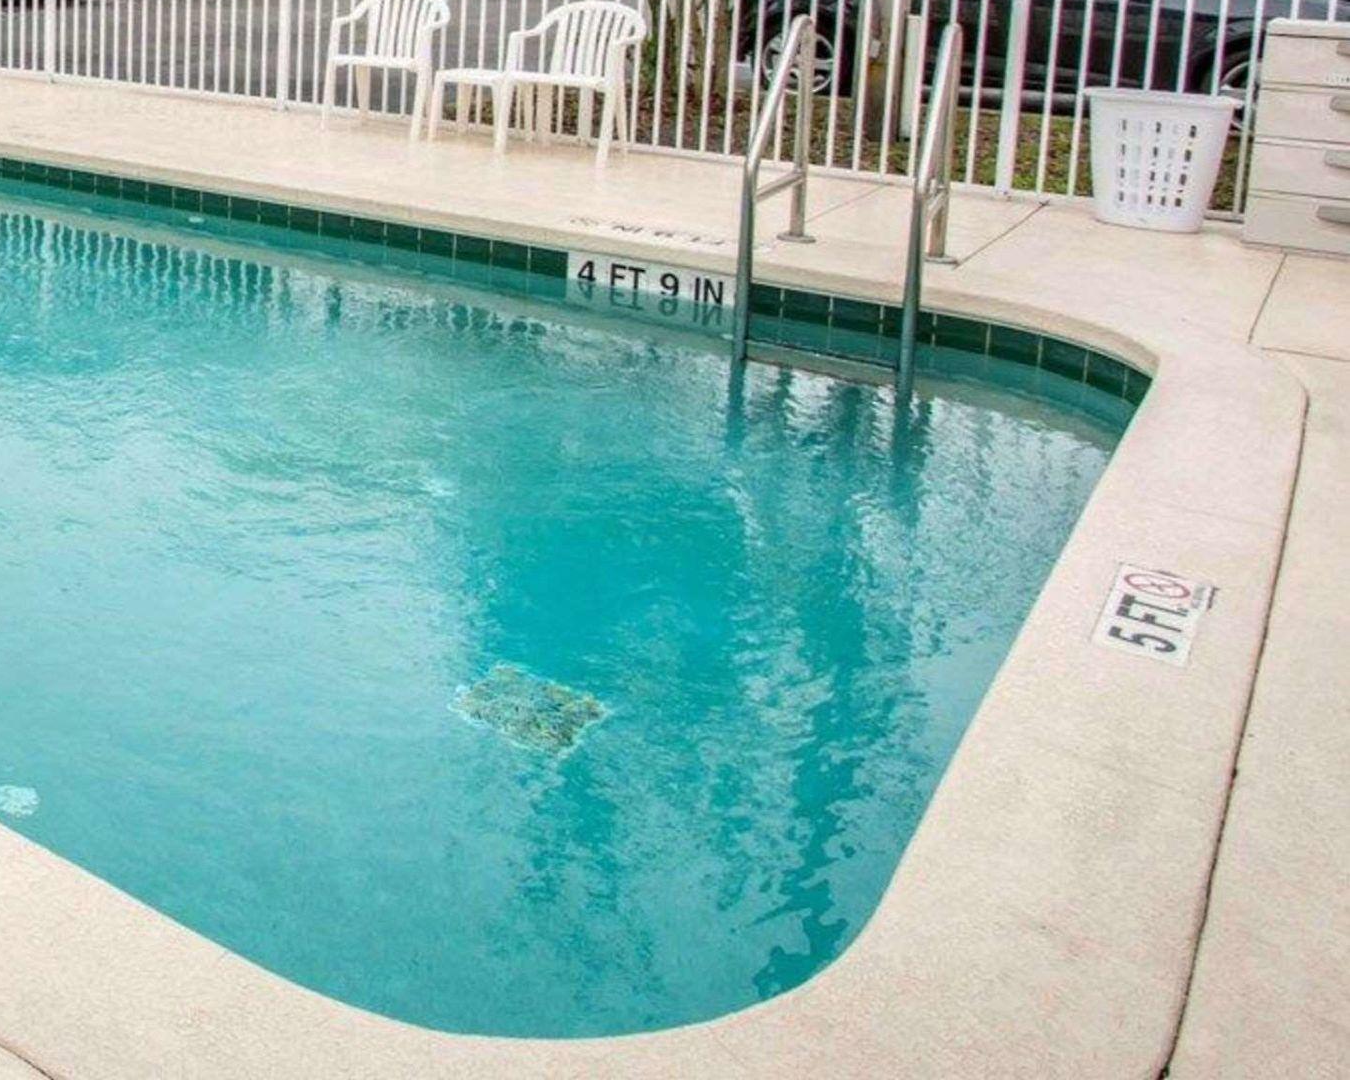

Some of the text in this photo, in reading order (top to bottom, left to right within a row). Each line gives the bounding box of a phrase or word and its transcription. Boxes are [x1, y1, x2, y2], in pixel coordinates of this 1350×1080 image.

[577, 261, 724, 305] 4 FT 9 IN
[1108, 626, 1177, 653] 5
